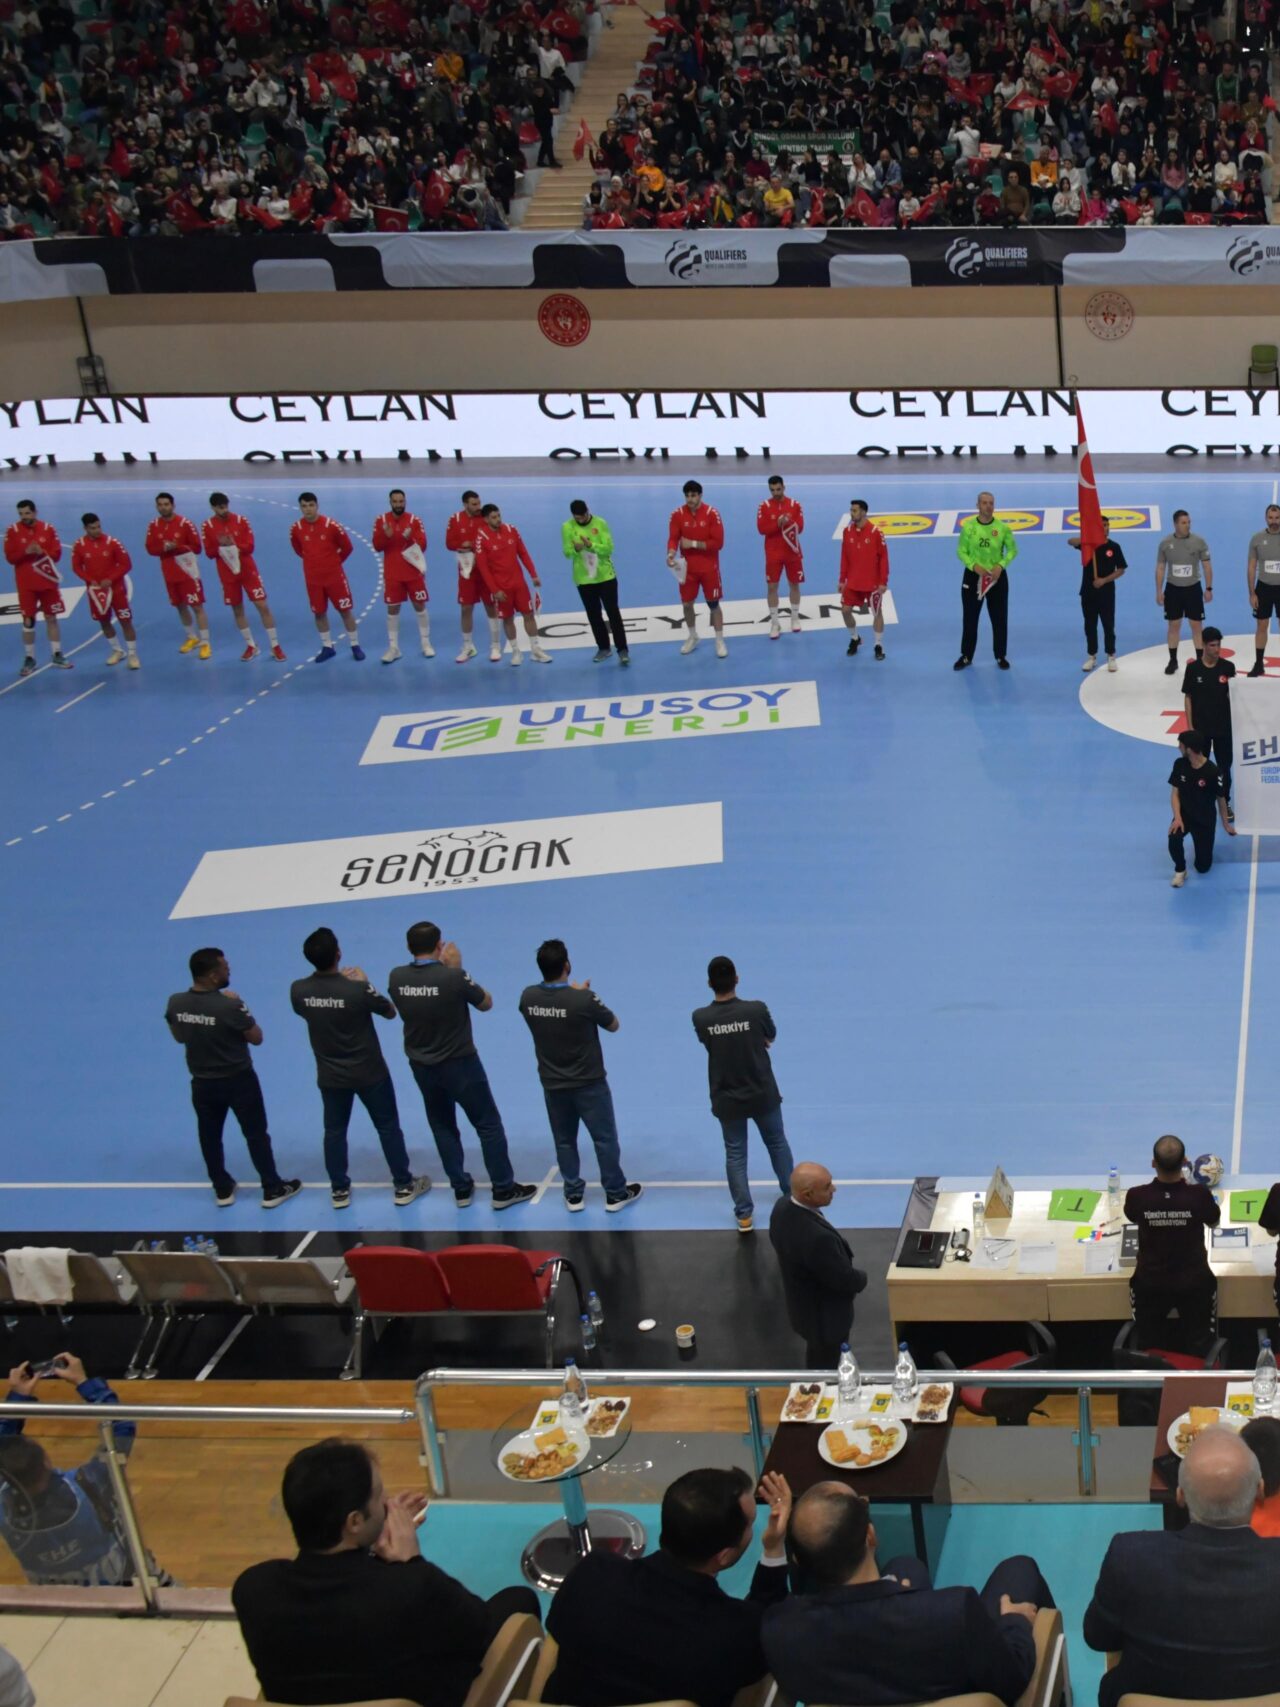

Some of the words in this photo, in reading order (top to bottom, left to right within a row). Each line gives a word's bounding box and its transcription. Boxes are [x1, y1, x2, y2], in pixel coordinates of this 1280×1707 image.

[704, 249, 747, 261] QUALIFIERS
[985, 247, 1028, 260] QUALIFIERS
[230, 394, 457, 422] CEYLAN
[538, 391, 767, 419] CEYLAN
[849, 390, 1078, 418] CEYLAN
[978, 538, 991, 549] 26
[252, 587, 265, 599] 23
[415, 590, 427, 600] 20
[338, 598, 352, 609] 22
[518, 688, 791, 726] ULUSOY
[515, 708, 781, 745] ENERJİ
[423, 875, 480, 888] 1953
[398, 985, 439, 997] TÜRKİYE
[303, 996, 345, 1009] TÜRKİYE
[527, 1005, 568, 1018] TÜRKİYE
[176, 1013, 216, 1026] TÜRKİYE
[707, 1020, 750, 1036] TÜRKİYE
[1239, 1200, 1258, 1215] T
[1144, 1210, 1167, 1219] TÜRKİYE
[1168, 1210, 1193, 1219] HENTBOL
[1149, 1219, 1187, 1227] FEDERASYONU
